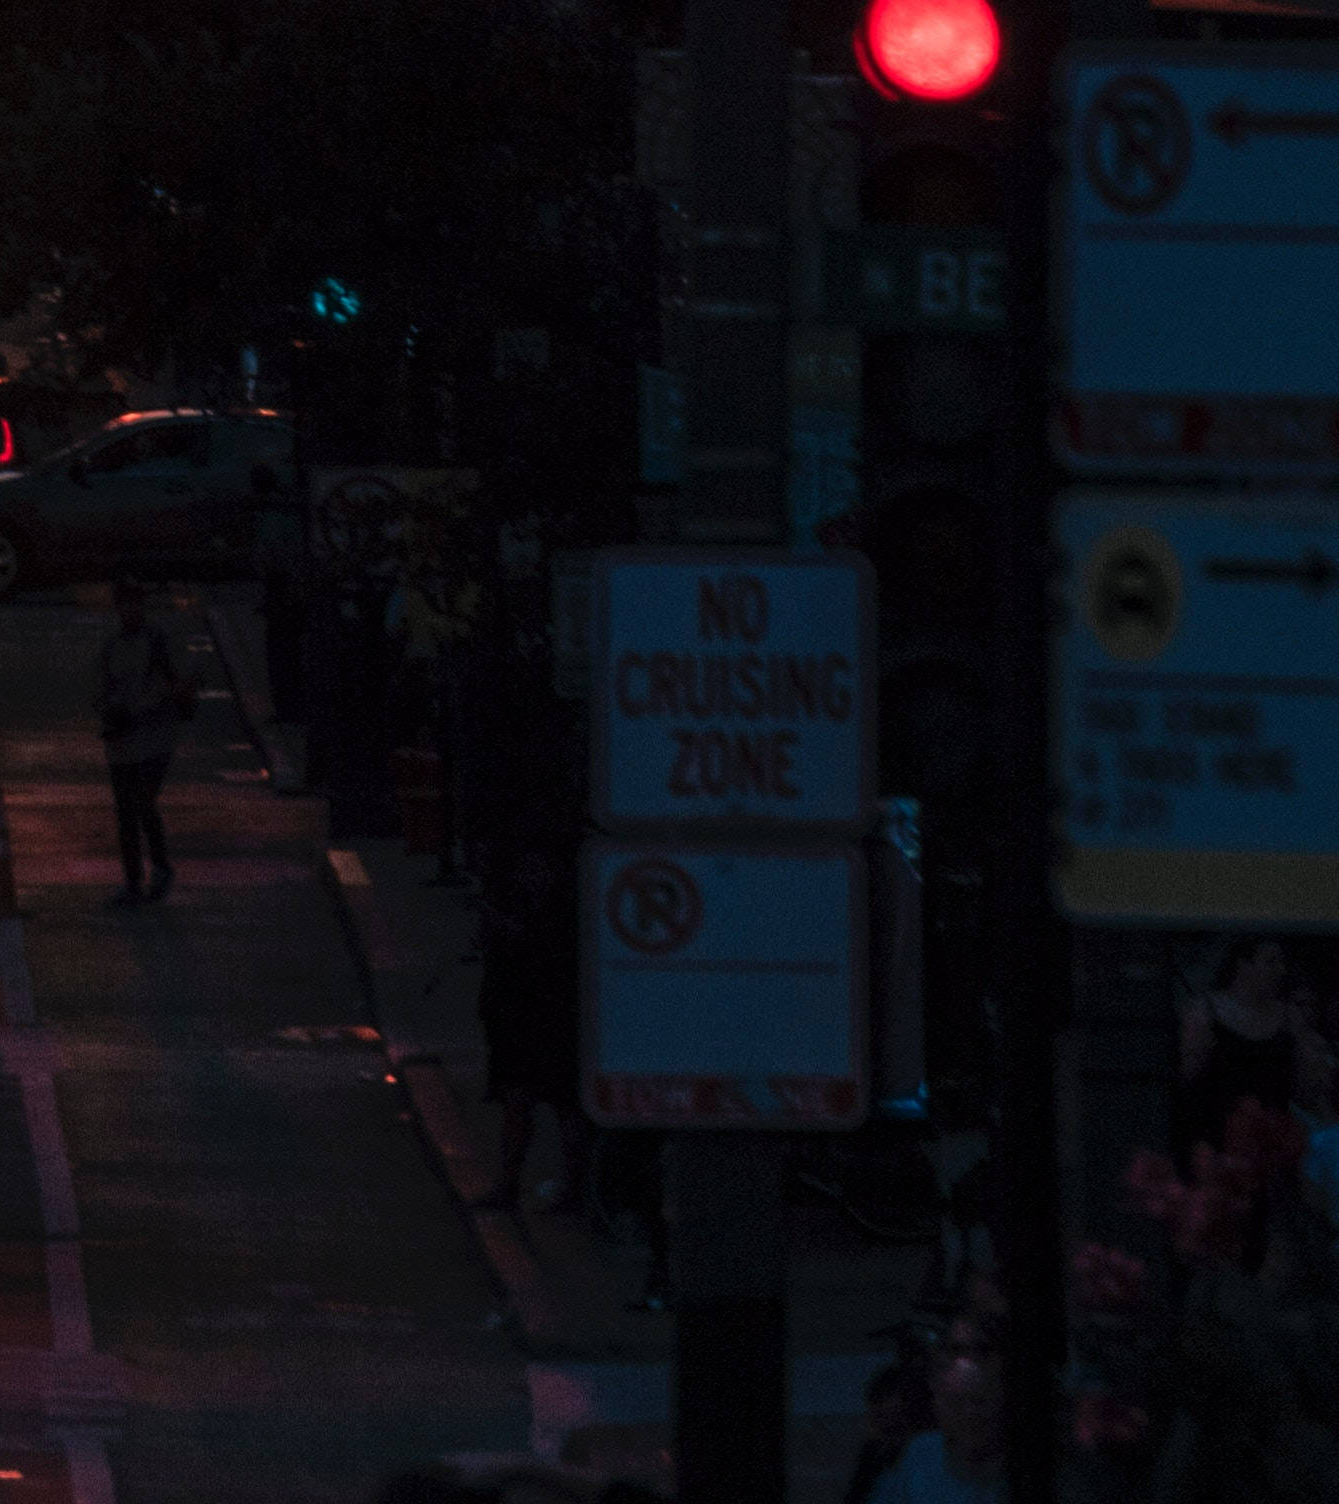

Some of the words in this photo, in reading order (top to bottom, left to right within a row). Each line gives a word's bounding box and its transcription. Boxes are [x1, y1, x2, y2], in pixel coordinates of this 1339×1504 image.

[699, 577, 767, 643] NO
[614, 654, 852, 723] CRUISING
[669, 731, 801, 799] ZONE
